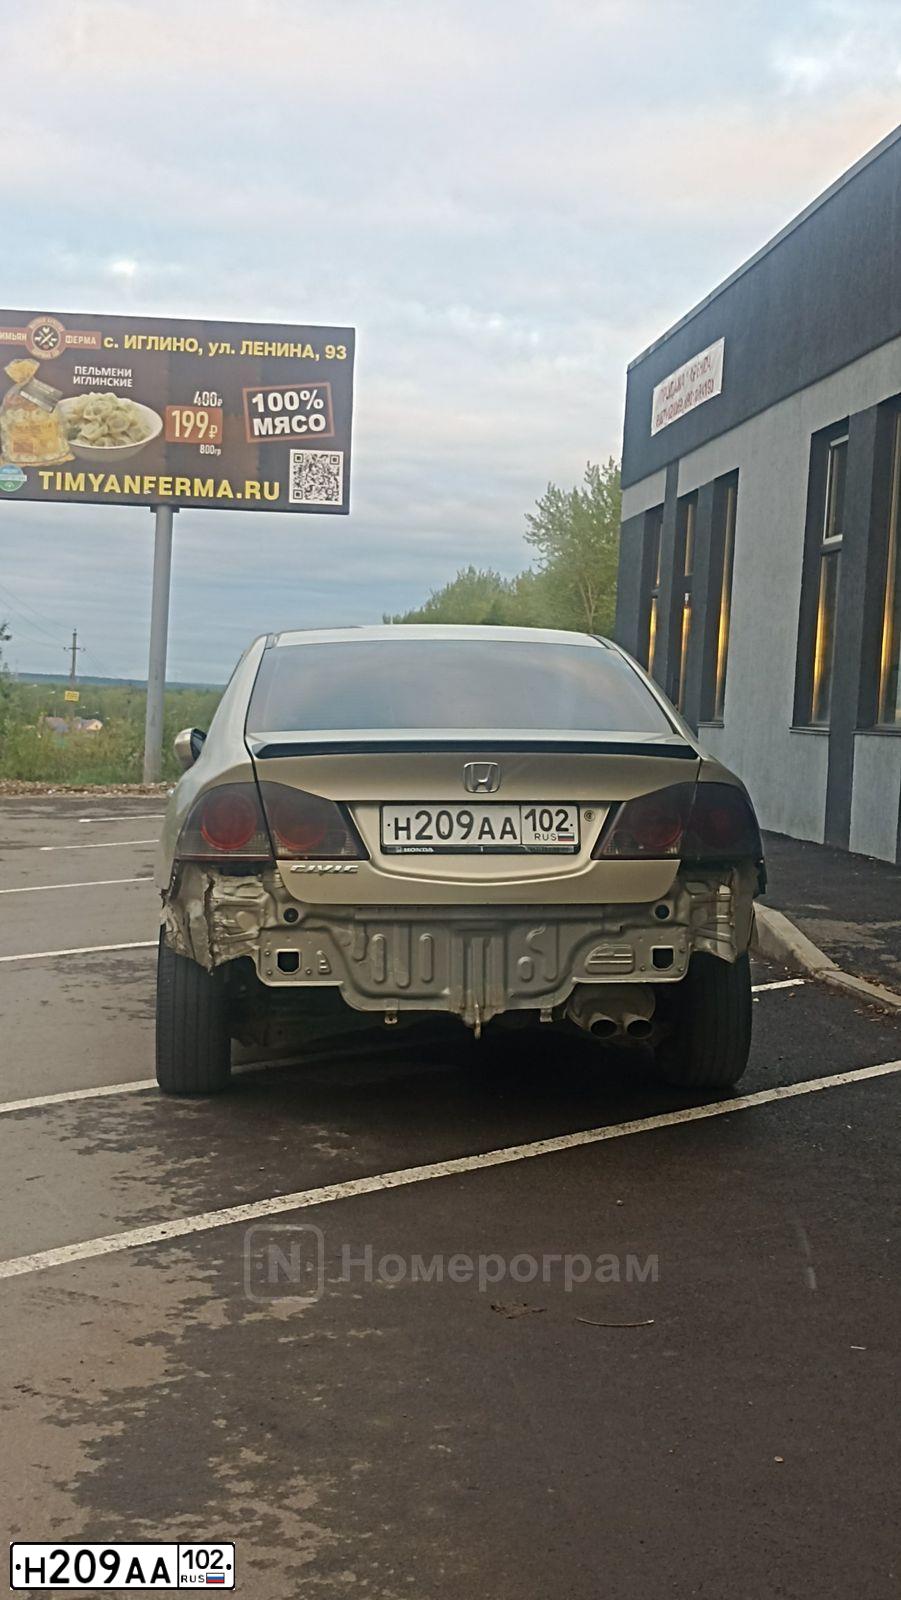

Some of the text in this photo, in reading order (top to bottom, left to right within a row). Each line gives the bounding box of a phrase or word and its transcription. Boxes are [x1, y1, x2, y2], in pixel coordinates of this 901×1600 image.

[65, 335, 96, 345] ФЕРМА
[104, 335, 347, 361] с. ИГЛИНО, ул. ЛЕНИНА, 93
[74, 366, 132, 377] ПЕЛЬМЕНИ
[73, 376, 133, 388] ИГЛИНСКИЕ
[252, 389, 324, 413] 100%
[253, 414, 326, 436] МЯСО
[38, 471, 280, 500] TIMYANFERMA.RU
[524, 808, 569, 832] 102
[534, 833, 557, 841] RUS
[290, 864, 359, 875] CIVIC
